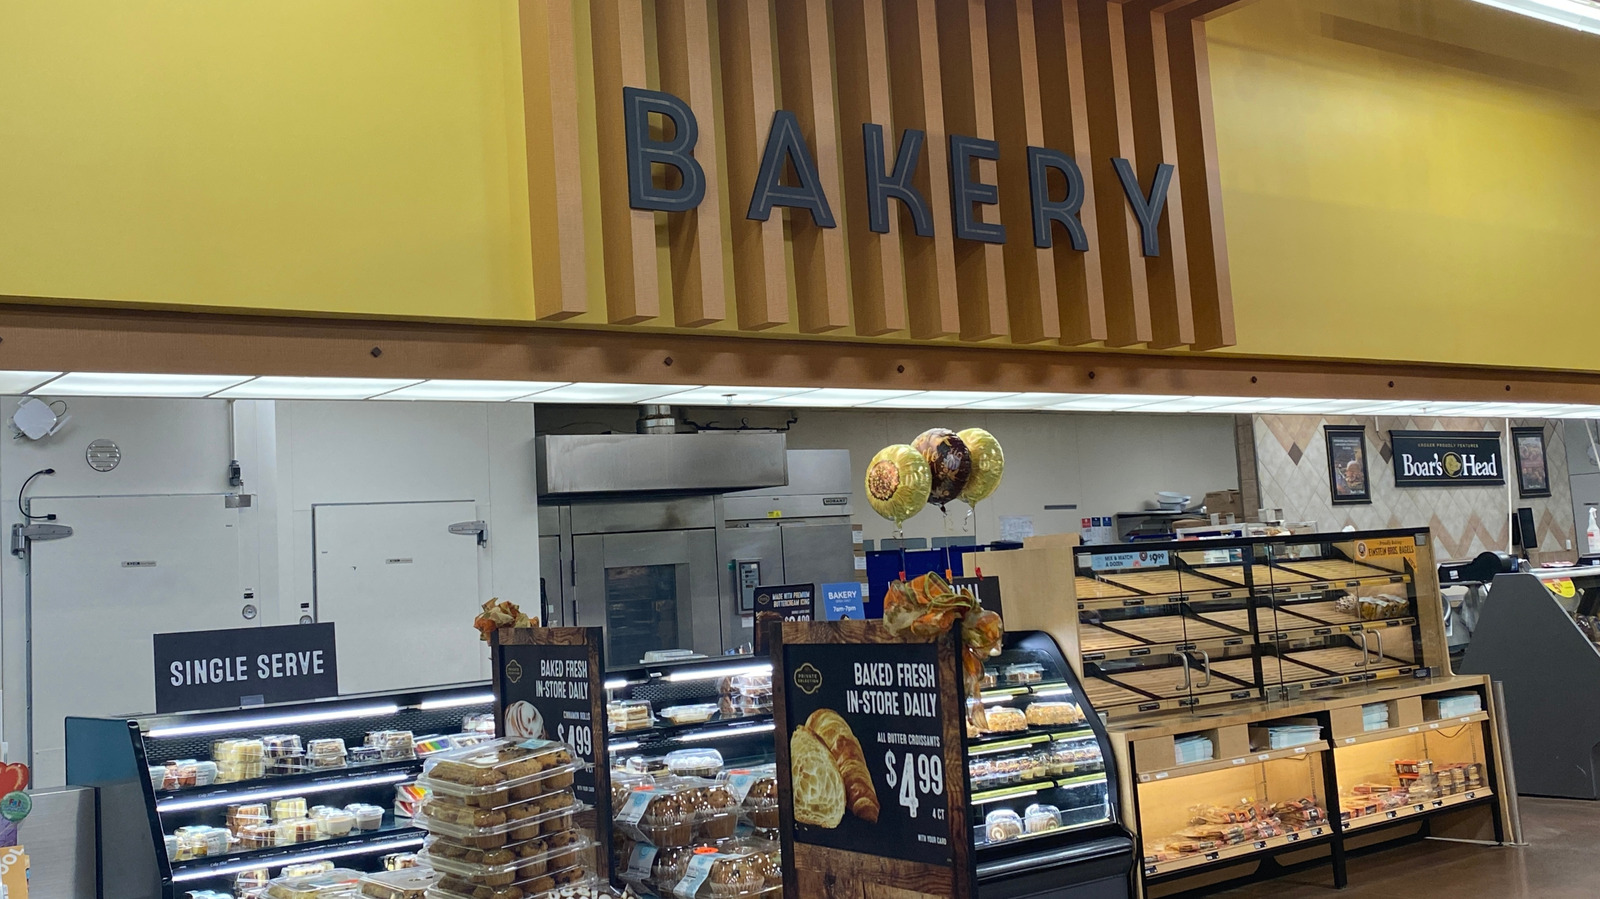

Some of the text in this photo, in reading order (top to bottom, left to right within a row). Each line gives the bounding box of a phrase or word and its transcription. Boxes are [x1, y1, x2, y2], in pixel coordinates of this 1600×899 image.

[623, 86, 1175, 258] BAKERY
[1402, 452, 1498, 476] Boar's Head
[828, 590, 857, 600] BAKERY
[832, 605, 857, 613] 7am-7pm
[170, 650, 325, 687] SINGLE SERVE
[541, 660, 588, 678] BAKED FRESH
[854, 662, 936, 688] BAKED FRESH
[535, 680, 589, 700] IN-STORE DAILY
[846, 690, 937, 717] IN-STORE DAILY
[877, 732, 940, 747] ALL BUTTER CROISSANTS
[932, 808, 945, 820] 4 CT
